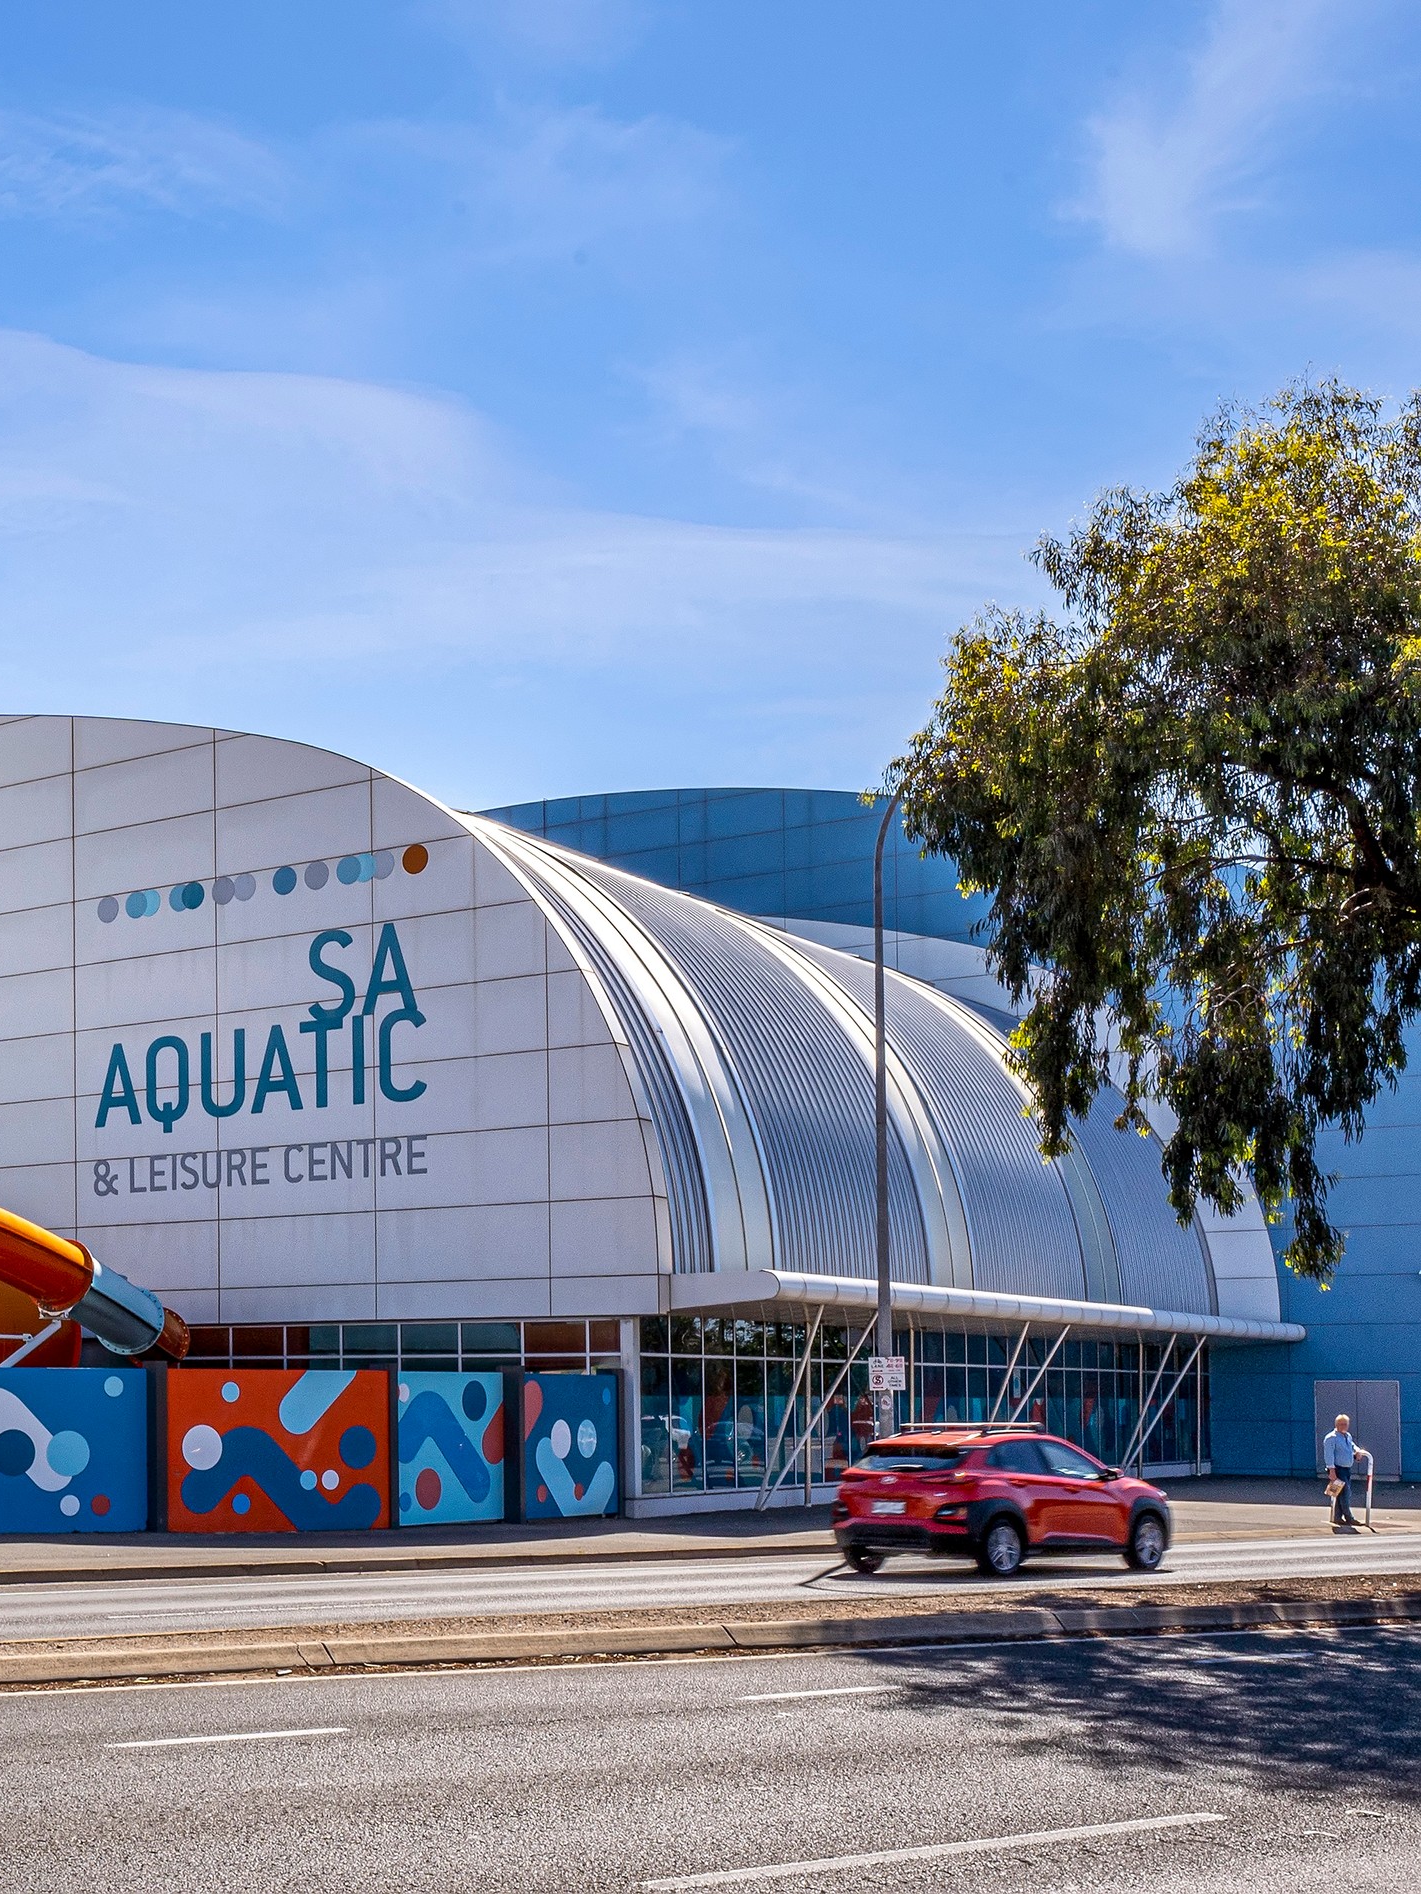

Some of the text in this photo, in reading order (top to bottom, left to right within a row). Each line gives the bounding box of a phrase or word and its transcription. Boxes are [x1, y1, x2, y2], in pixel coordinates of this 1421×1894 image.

[308, 922, 418, 1021] SA
[94, 1008, 427, 1133] AQUATIC
[93, 1134, 428, 1196] & LEISURE CENTRE
